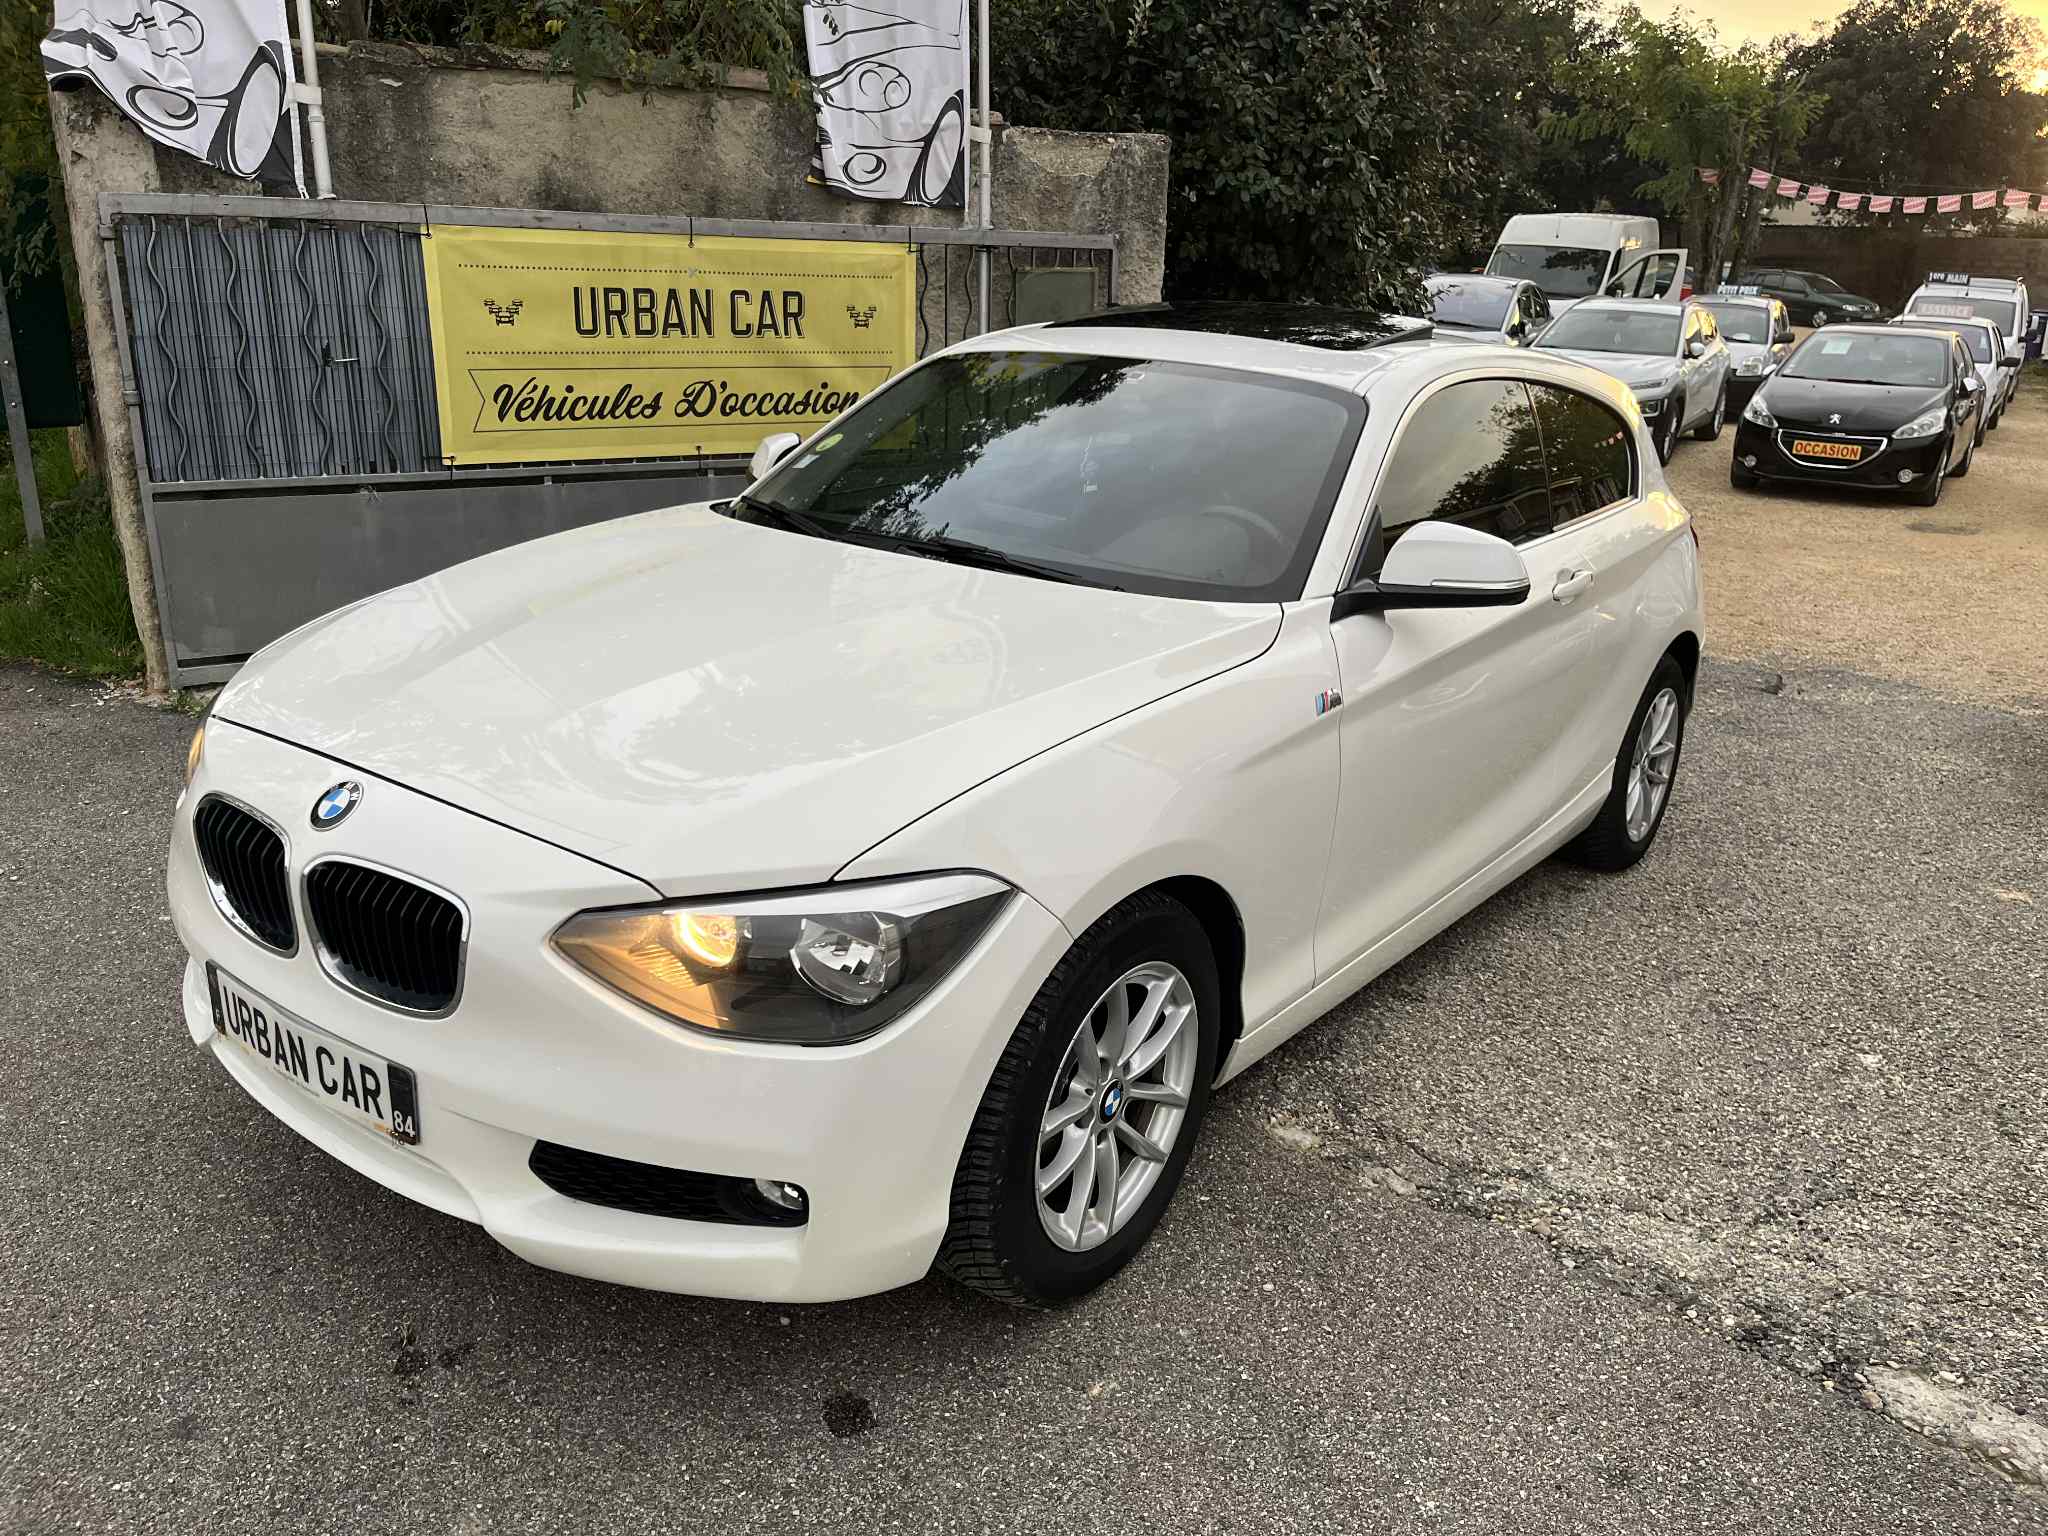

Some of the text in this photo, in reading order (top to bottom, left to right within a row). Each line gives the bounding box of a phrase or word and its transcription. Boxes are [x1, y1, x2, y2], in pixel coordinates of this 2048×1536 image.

[1946, 273, 1969, 284] MAIN
[573, 285, 806, 340] URBAN CAR
[493, 377, 860, 423] Véhicules D'occasion
[1795, 442, 1860, 458] OCCASION
[223, 986, 384, 1120] URBAN CAR
[393, 1110, 416, 1137] 84
